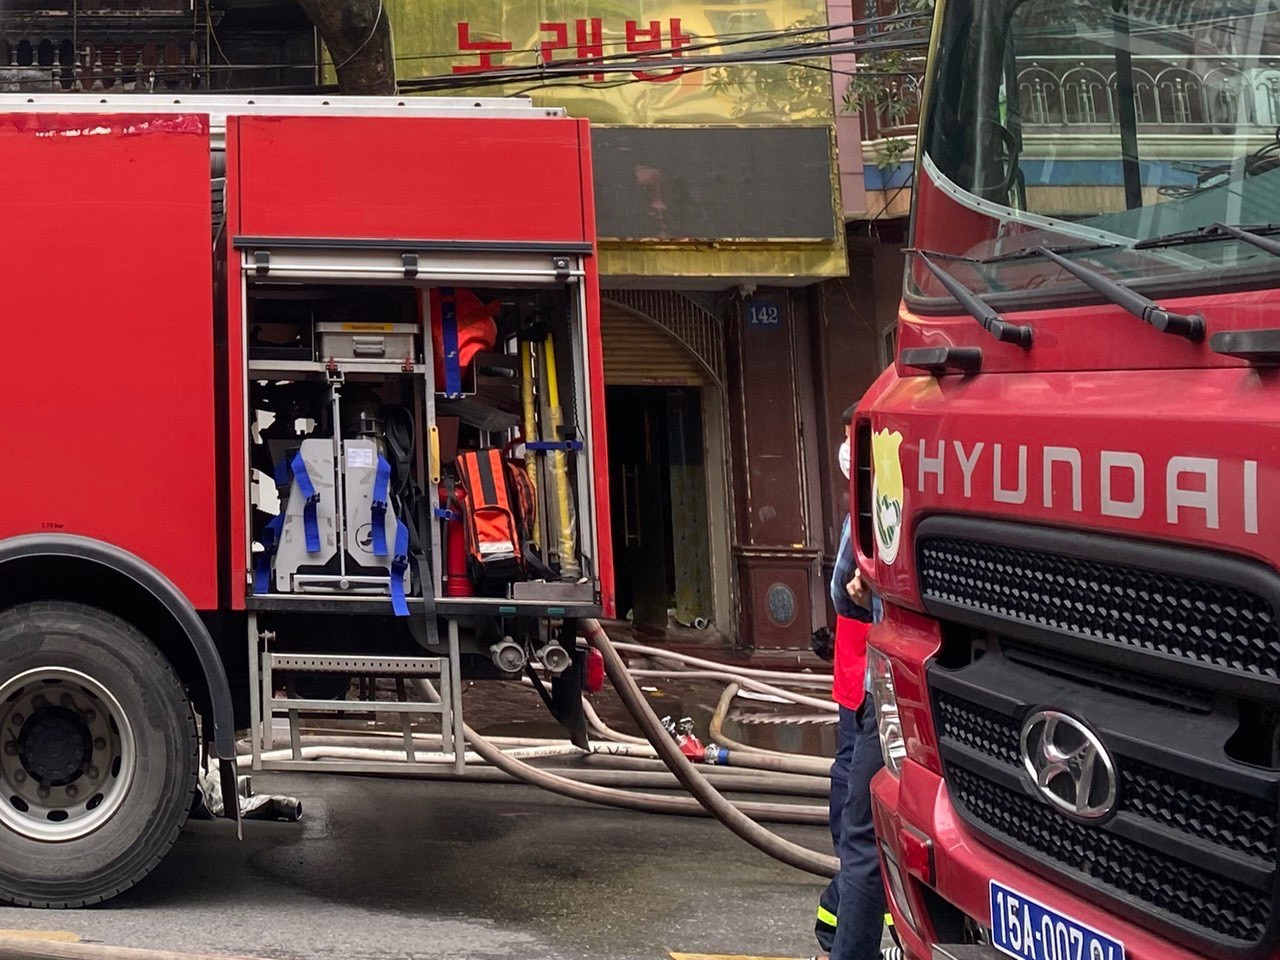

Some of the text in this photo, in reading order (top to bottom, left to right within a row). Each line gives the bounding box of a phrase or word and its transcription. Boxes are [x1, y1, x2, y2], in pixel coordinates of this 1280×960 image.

[452, 18, 691, 82] 노래방
[751, 306, 778, 323] 142
[918, 438, 1258, 534] HYUNDAI
